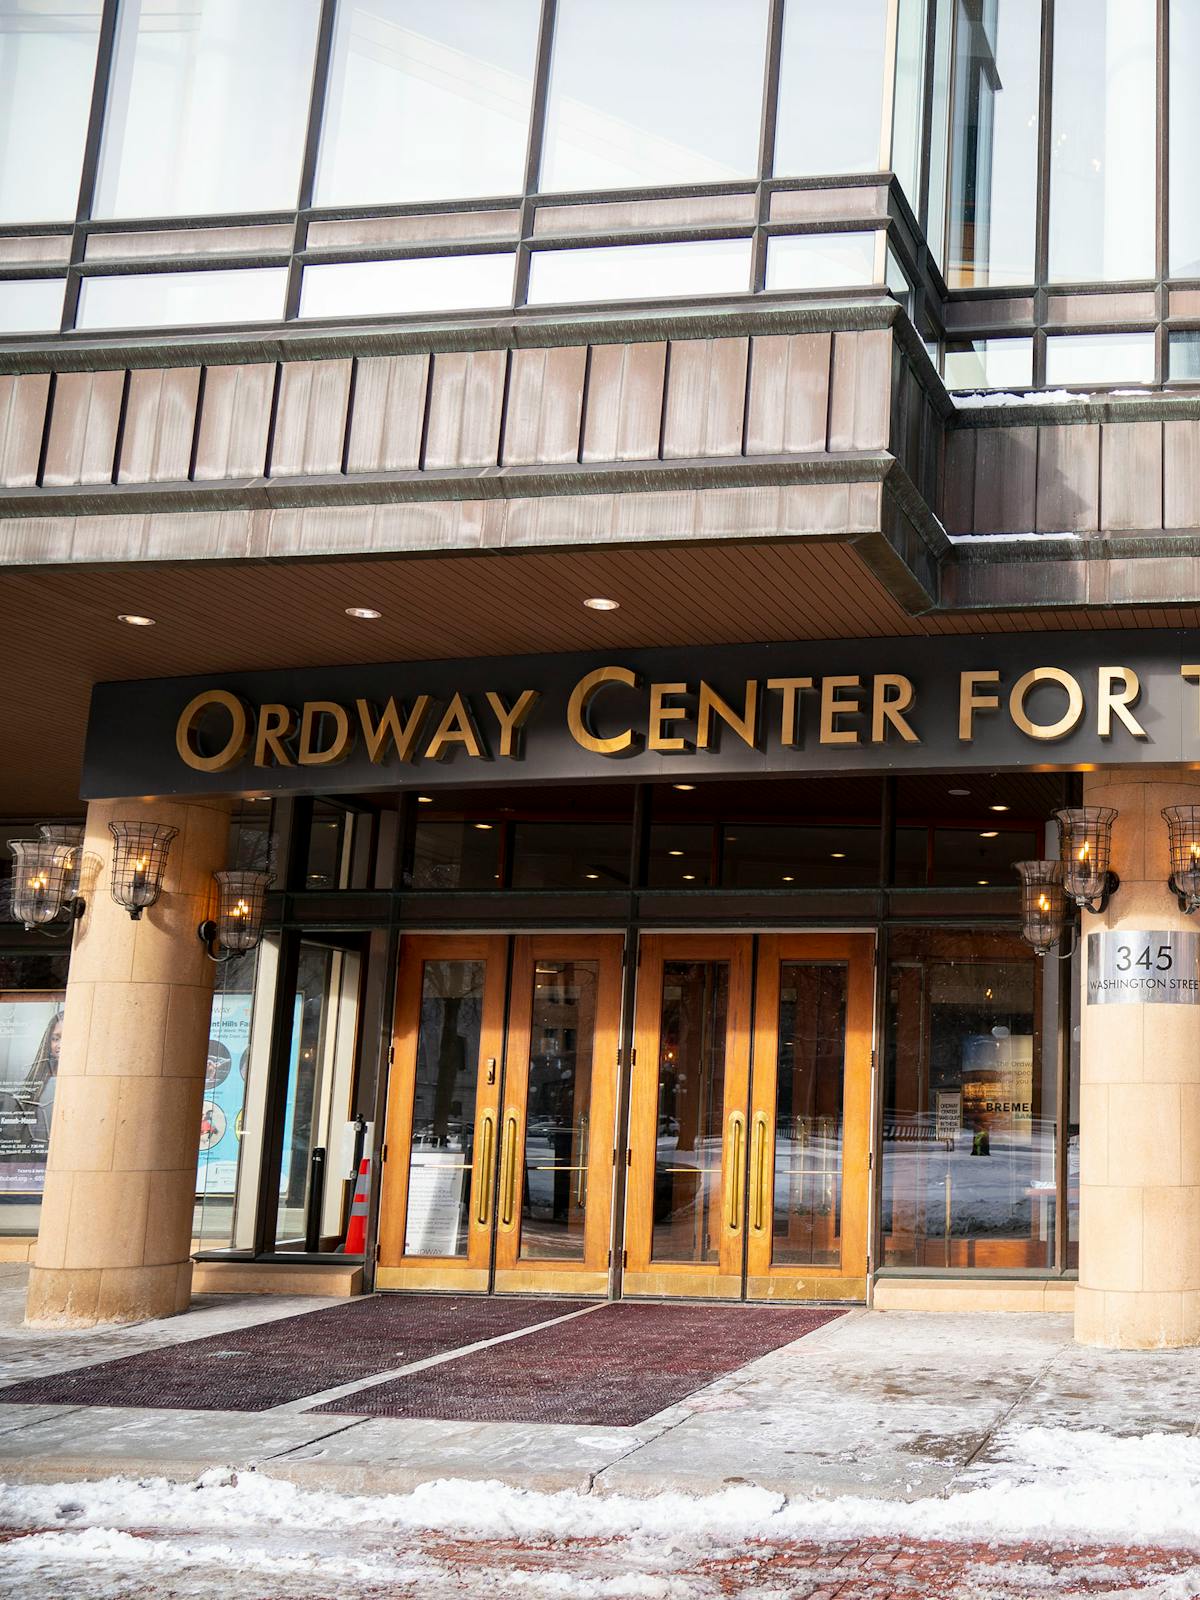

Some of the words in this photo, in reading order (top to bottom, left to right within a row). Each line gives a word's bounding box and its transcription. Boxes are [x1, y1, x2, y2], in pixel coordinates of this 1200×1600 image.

[176, 689, 542, 773] ORDWAY
[566, 665, 922, 755] CENTER
[958, 666, 1147, 741] FOR
[1116, 945, 1173, 971] 345
[1090, 978, 1167, 990] WASHINGTON
[1014, 1070, 1032, 1078] spec
[986, 1102, 1033, 1112] BREME
